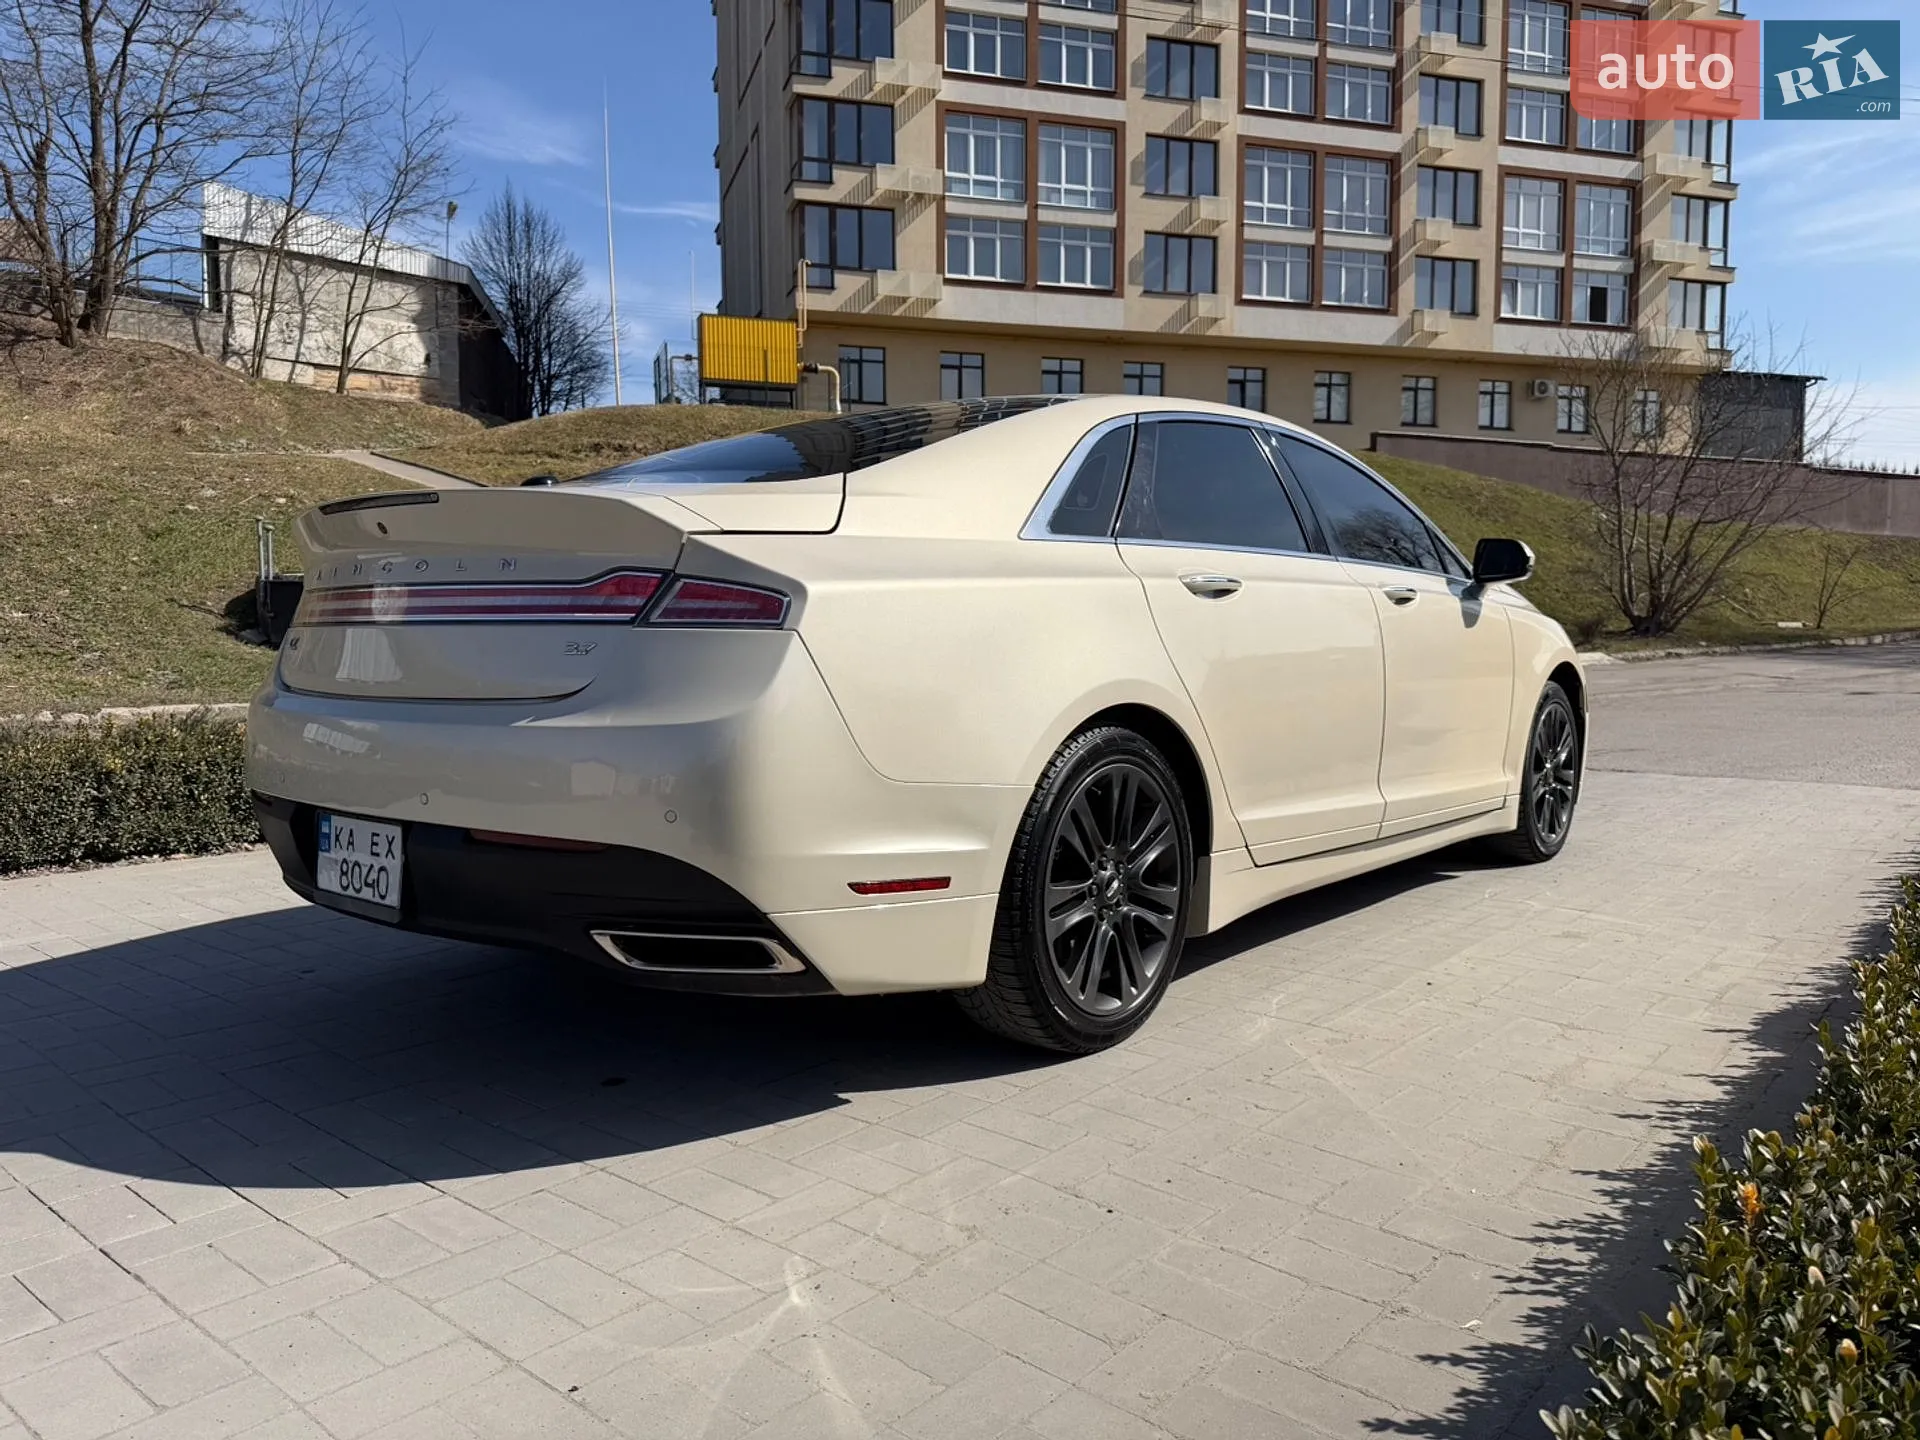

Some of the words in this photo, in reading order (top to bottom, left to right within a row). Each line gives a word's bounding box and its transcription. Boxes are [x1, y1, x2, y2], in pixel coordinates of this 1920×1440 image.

[316, 558, 516, 580] LINCOLN
[334, 825, 355, 852] KA
[370, 831, 396, 860] EX
[340, 858, 389, 900] 8040
